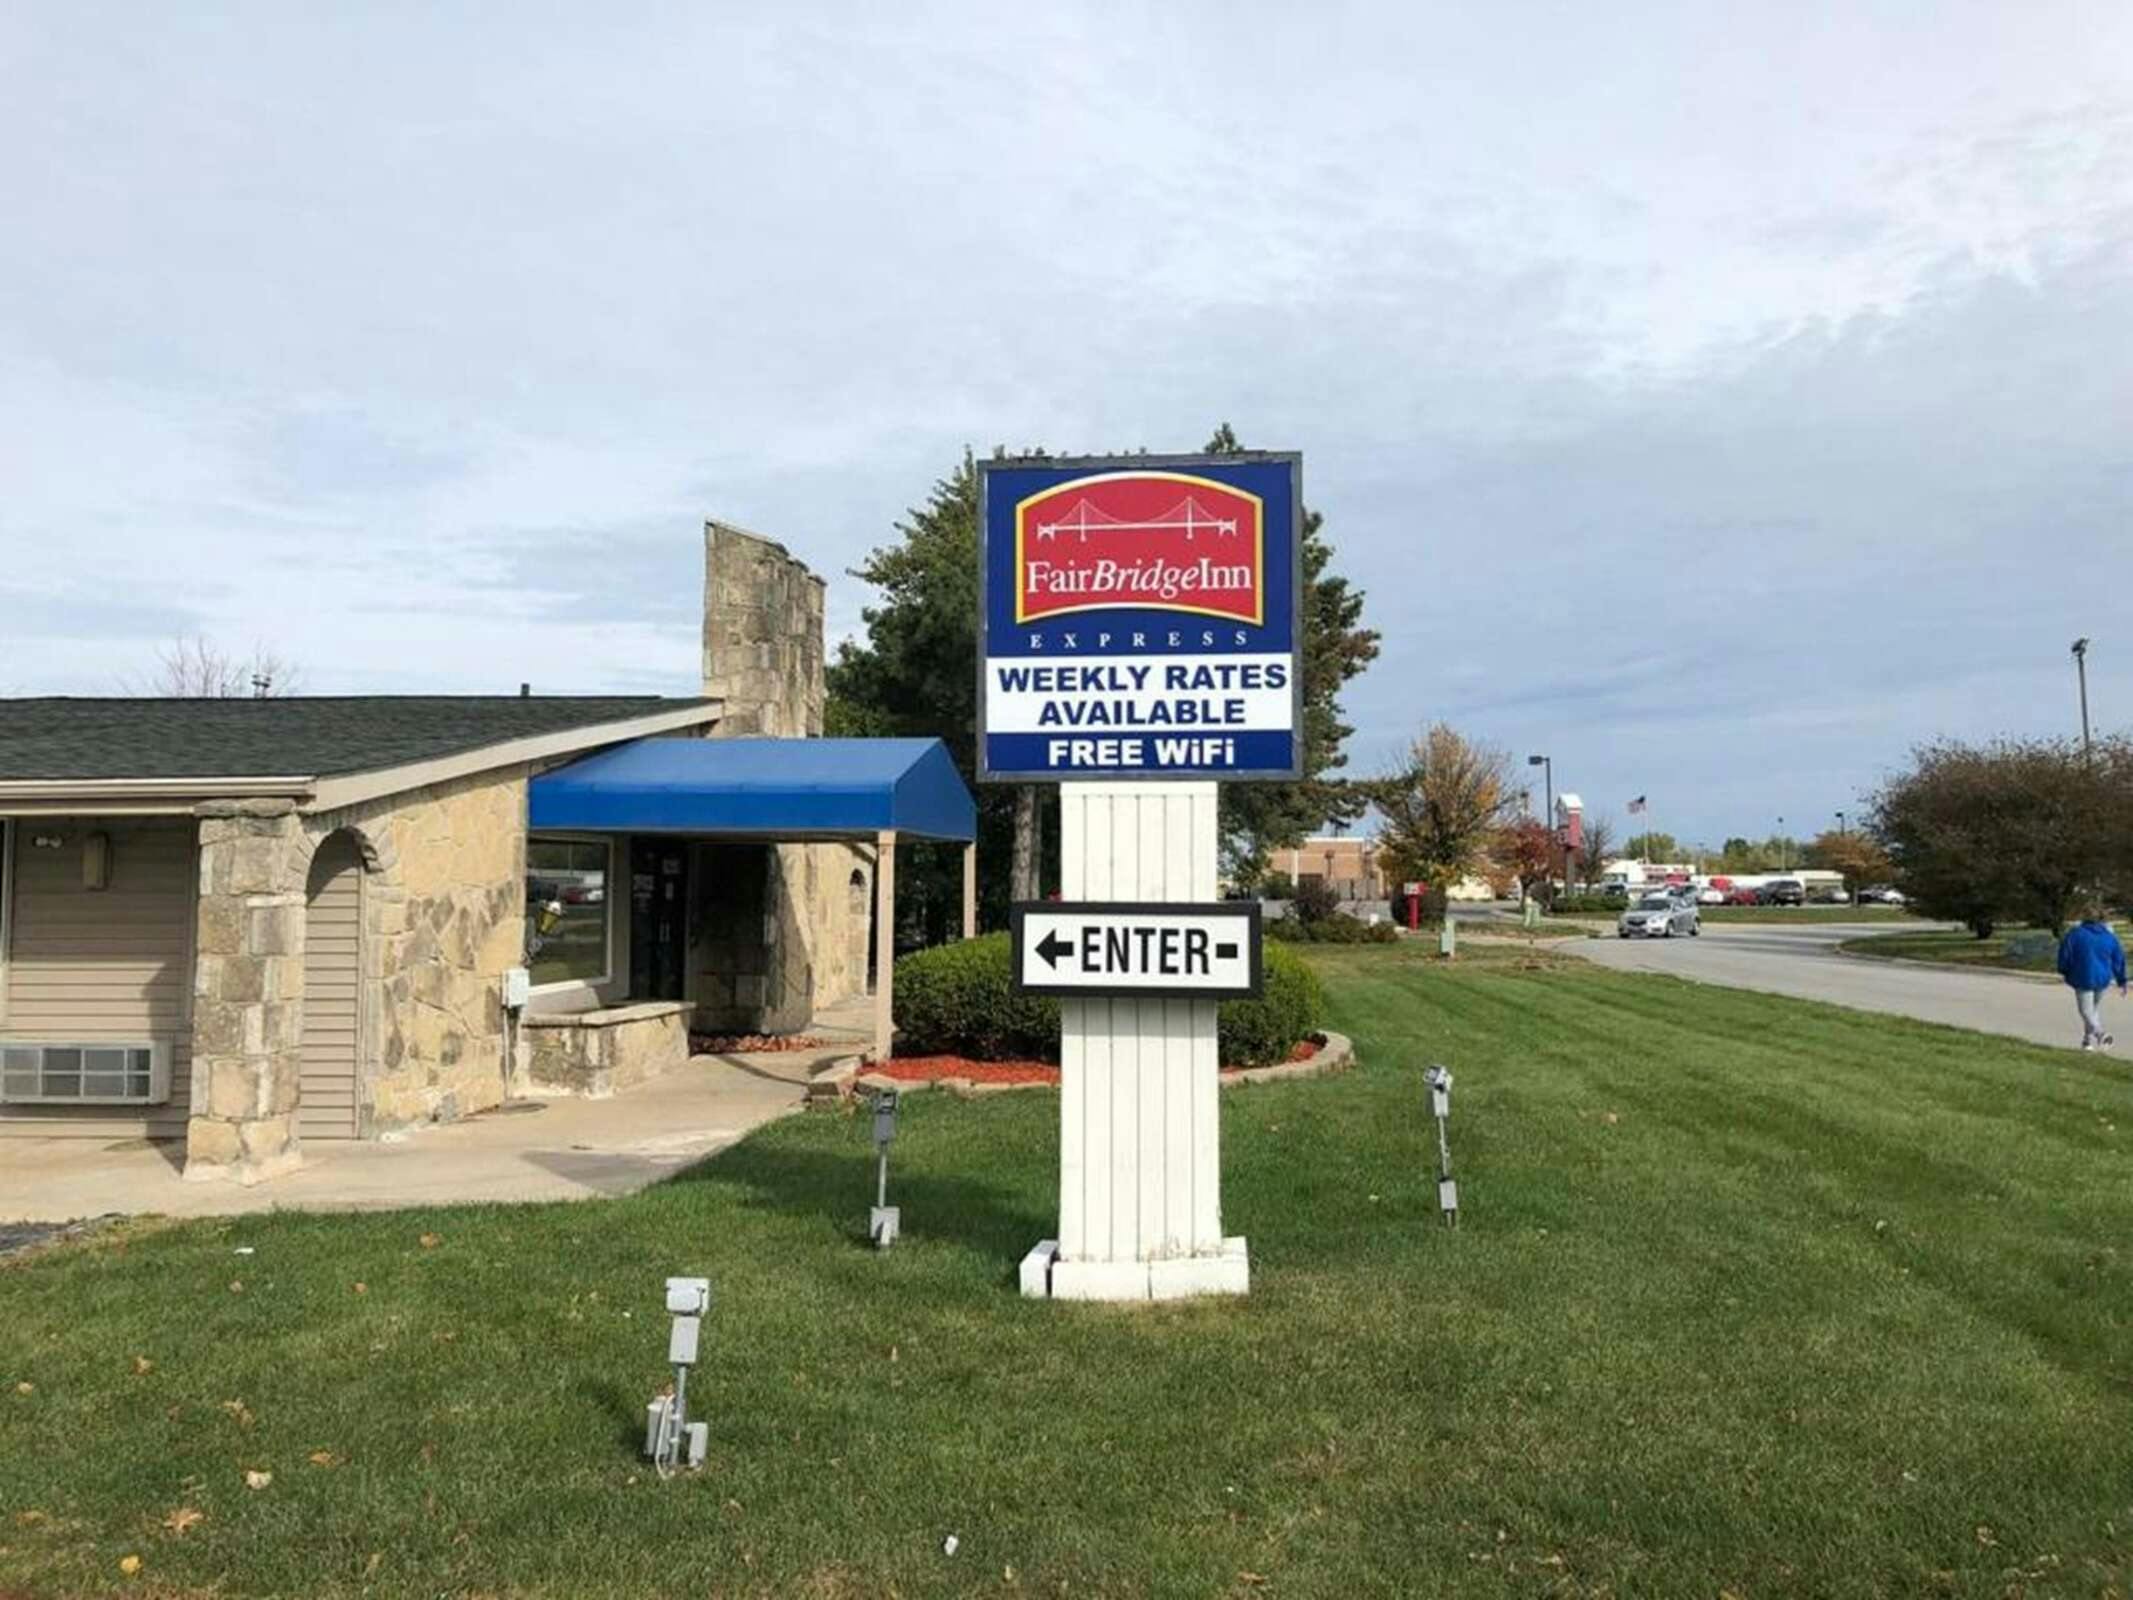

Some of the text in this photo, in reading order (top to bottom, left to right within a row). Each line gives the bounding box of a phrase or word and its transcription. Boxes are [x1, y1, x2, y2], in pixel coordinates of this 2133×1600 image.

[1030, 631, 1247, 649] EXPRESS
[998, 664, 1287, 692] WEEKLY RATES
[1038, 699, 1246, 726] AVAILABLE
[1049, 737, 1235, 766] FREE WiFi
[1082, 927, 1210, 975] ENTER
